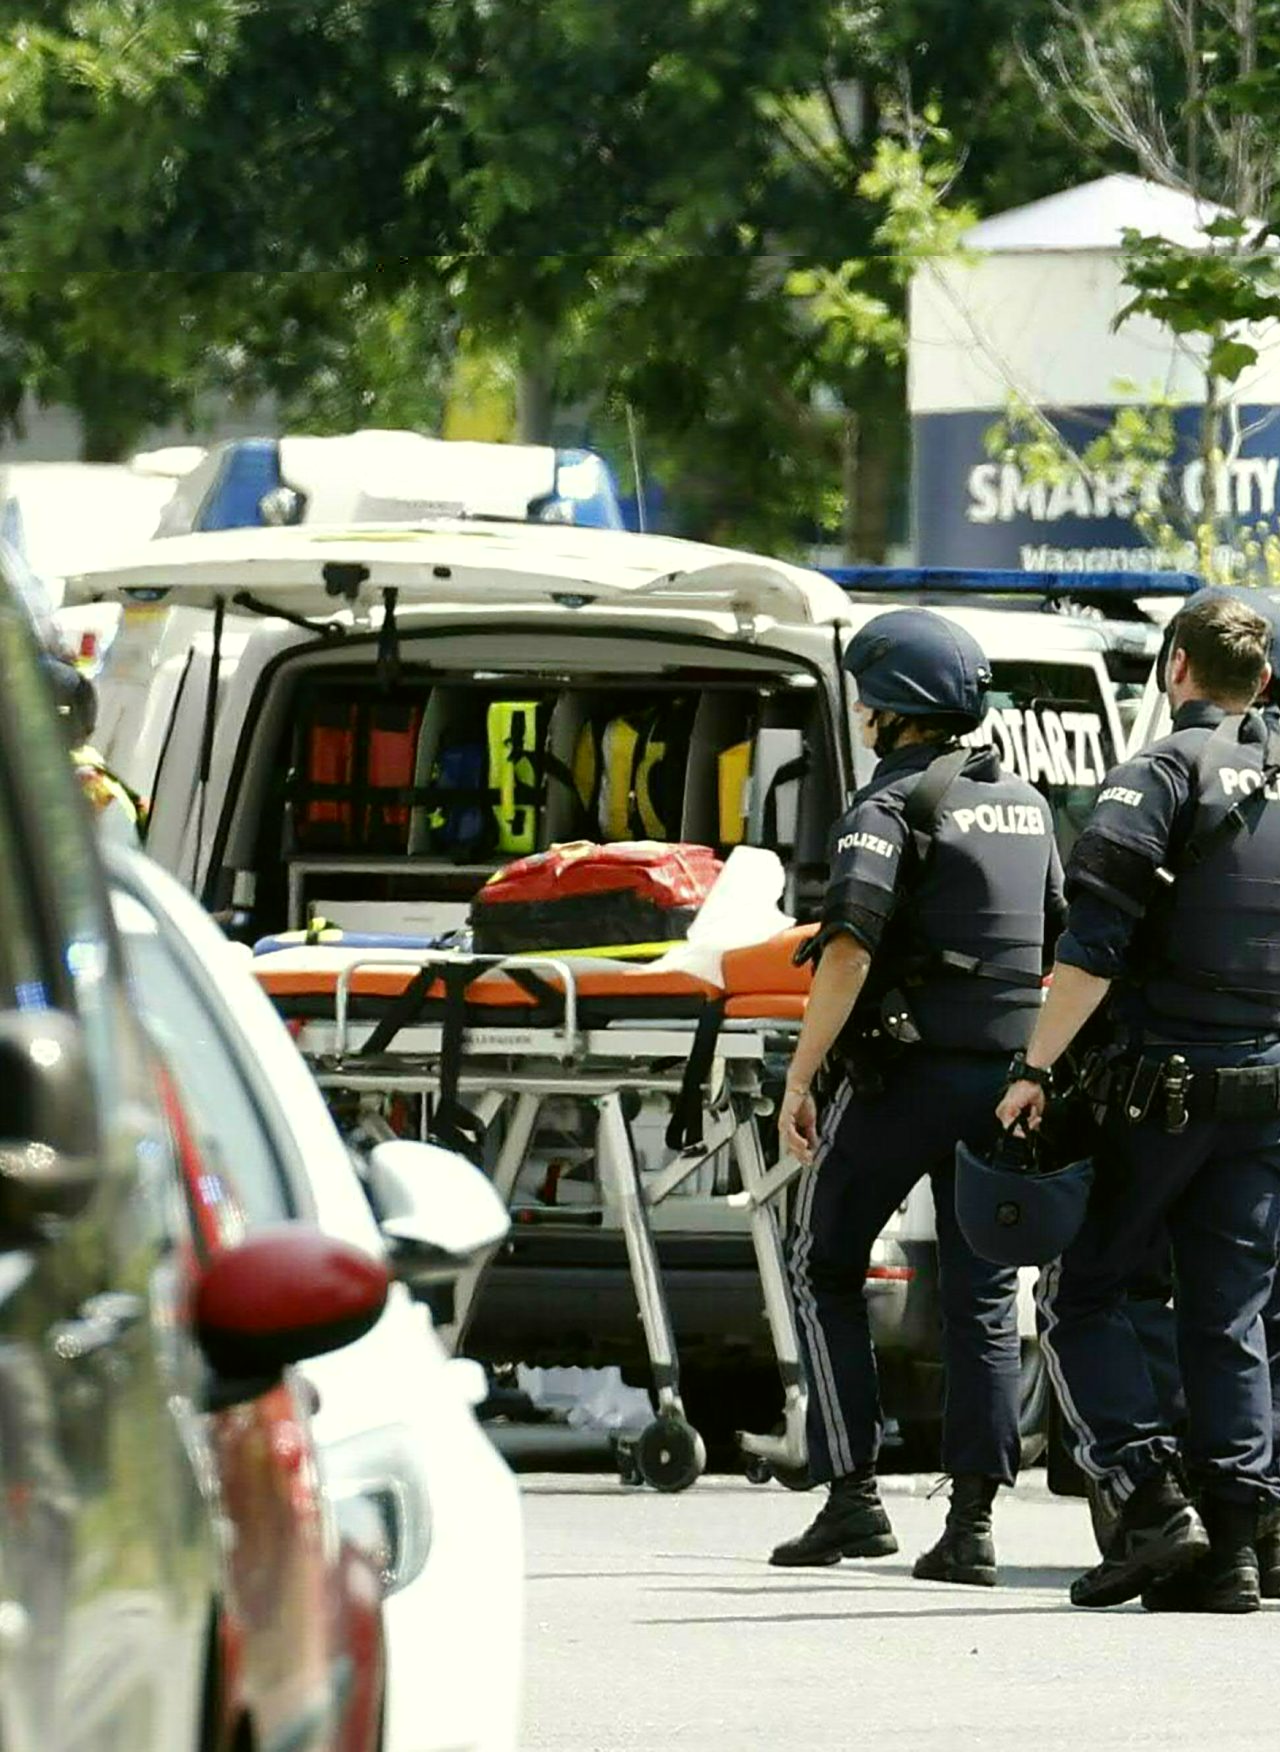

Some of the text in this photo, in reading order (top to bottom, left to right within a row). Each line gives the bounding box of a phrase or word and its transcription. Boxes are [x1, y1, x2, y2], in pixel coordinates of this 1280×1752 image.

[1183, 455, 1280, 514] CITY
[952, 803, 1046, 836] POLIZEI
[837, 831, 894, 859] POLIZEI
